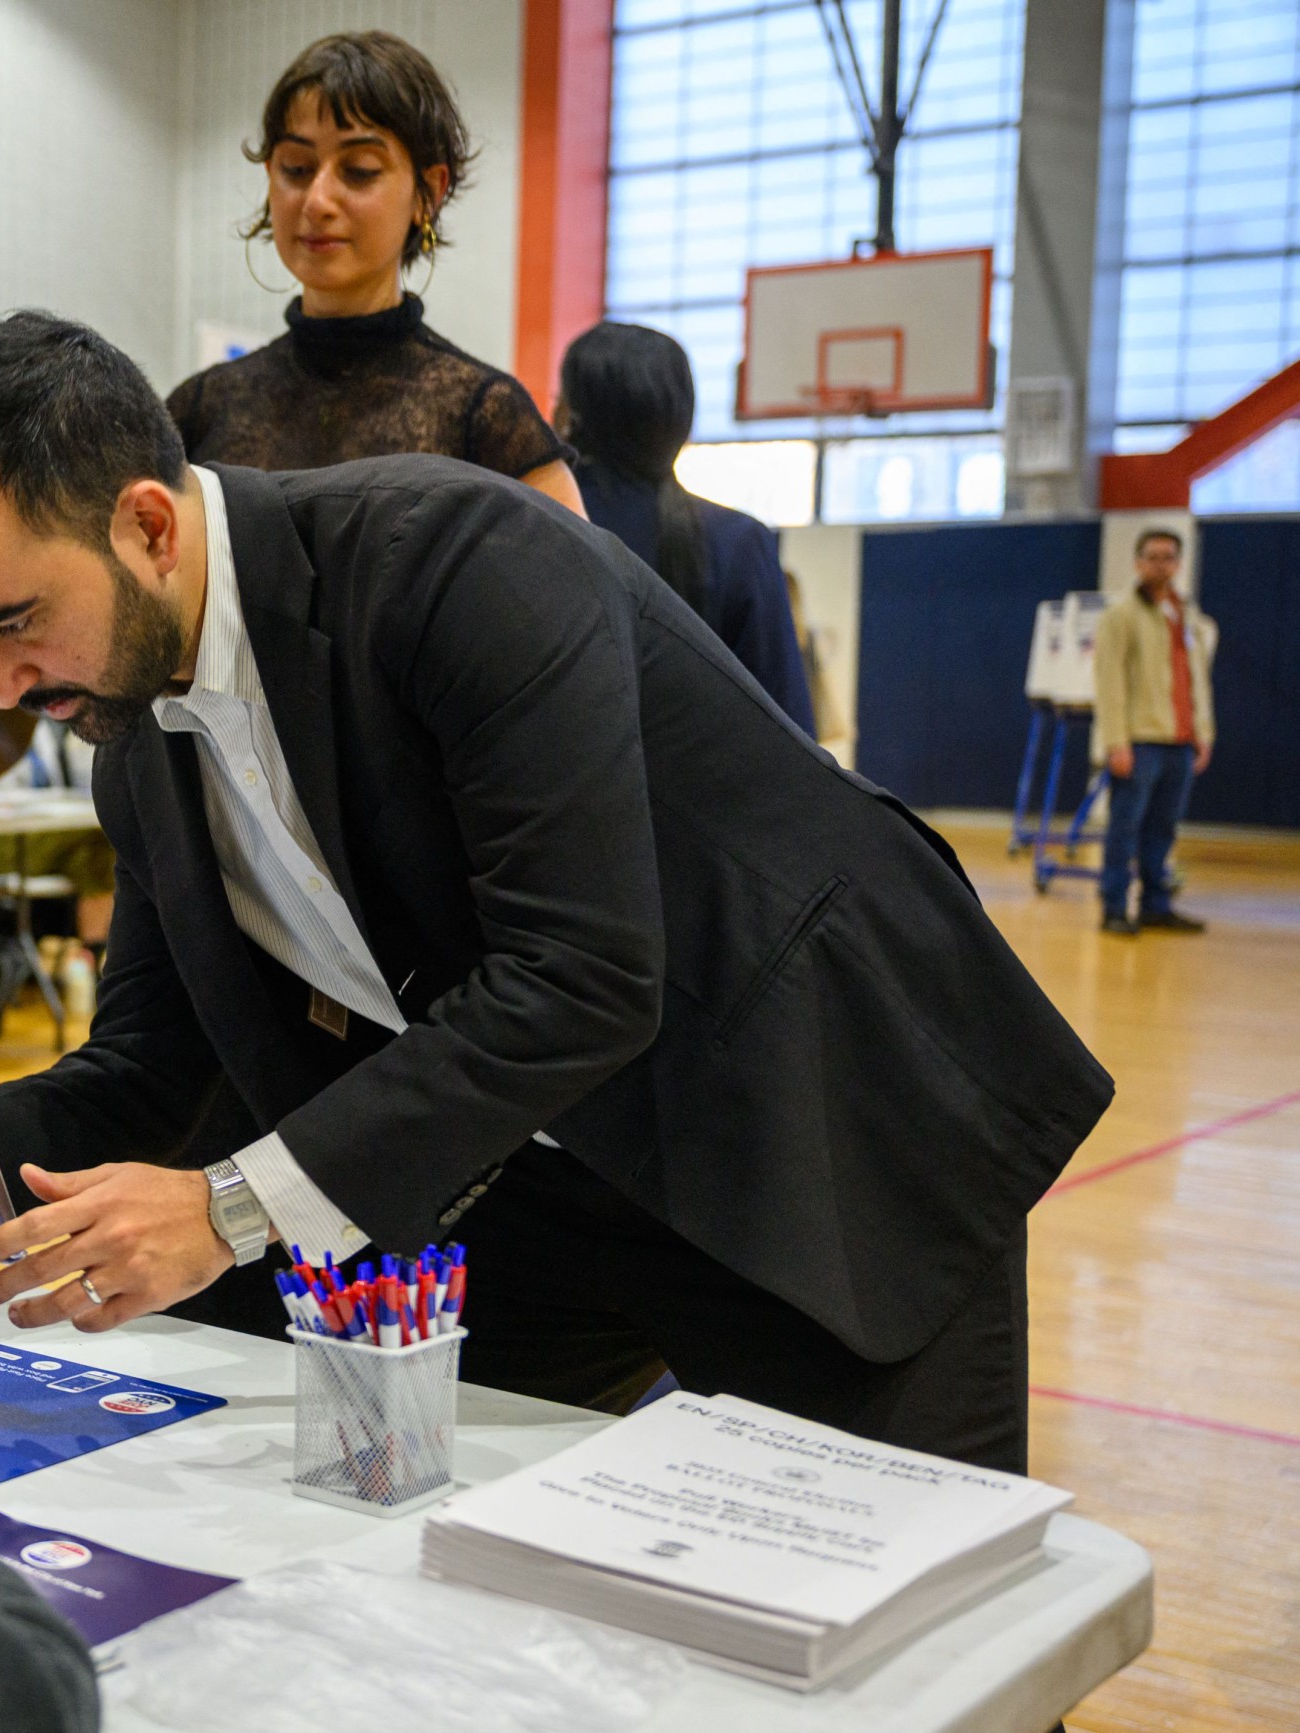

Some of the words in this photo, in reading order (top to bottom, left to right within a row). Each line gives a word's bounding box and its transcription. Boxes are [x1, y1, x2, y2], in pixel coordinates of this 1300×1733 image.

[713, 1423, 744, 1437] 25
[749, 1434, 828, 1461] copies
[832, 1456, 873, 1472] per
[878, 1466, 942, 1486] pack
